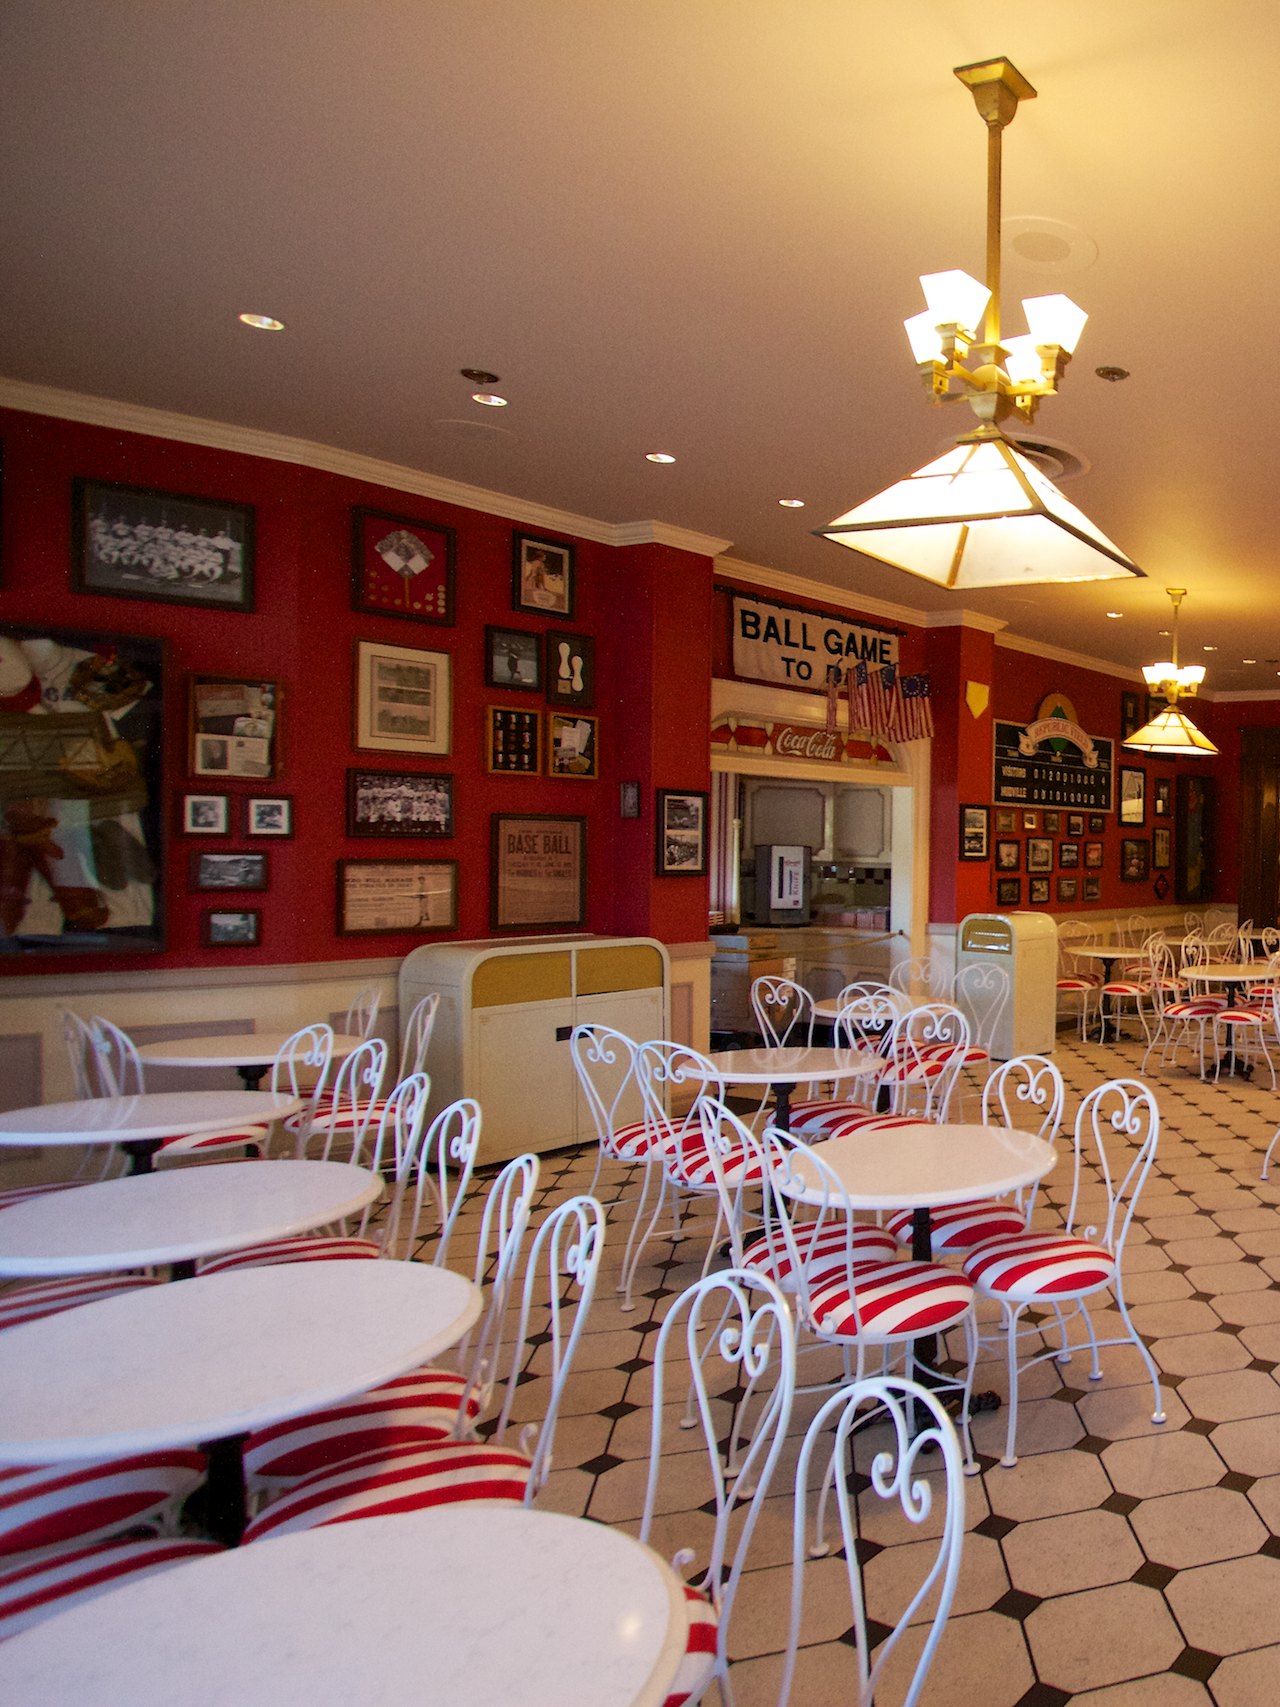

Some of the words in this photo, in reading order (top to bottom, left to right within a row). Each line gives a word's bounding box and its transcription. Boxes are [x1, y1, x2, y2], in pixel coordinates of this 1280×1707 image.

[740, 608, 816, 652] BALL
[824, 628, 891, 665] GAME
[781, 657, 812, 680] TO
[507, 834, 538, 854] BASE
[543, 834, 572, 854] BALL
